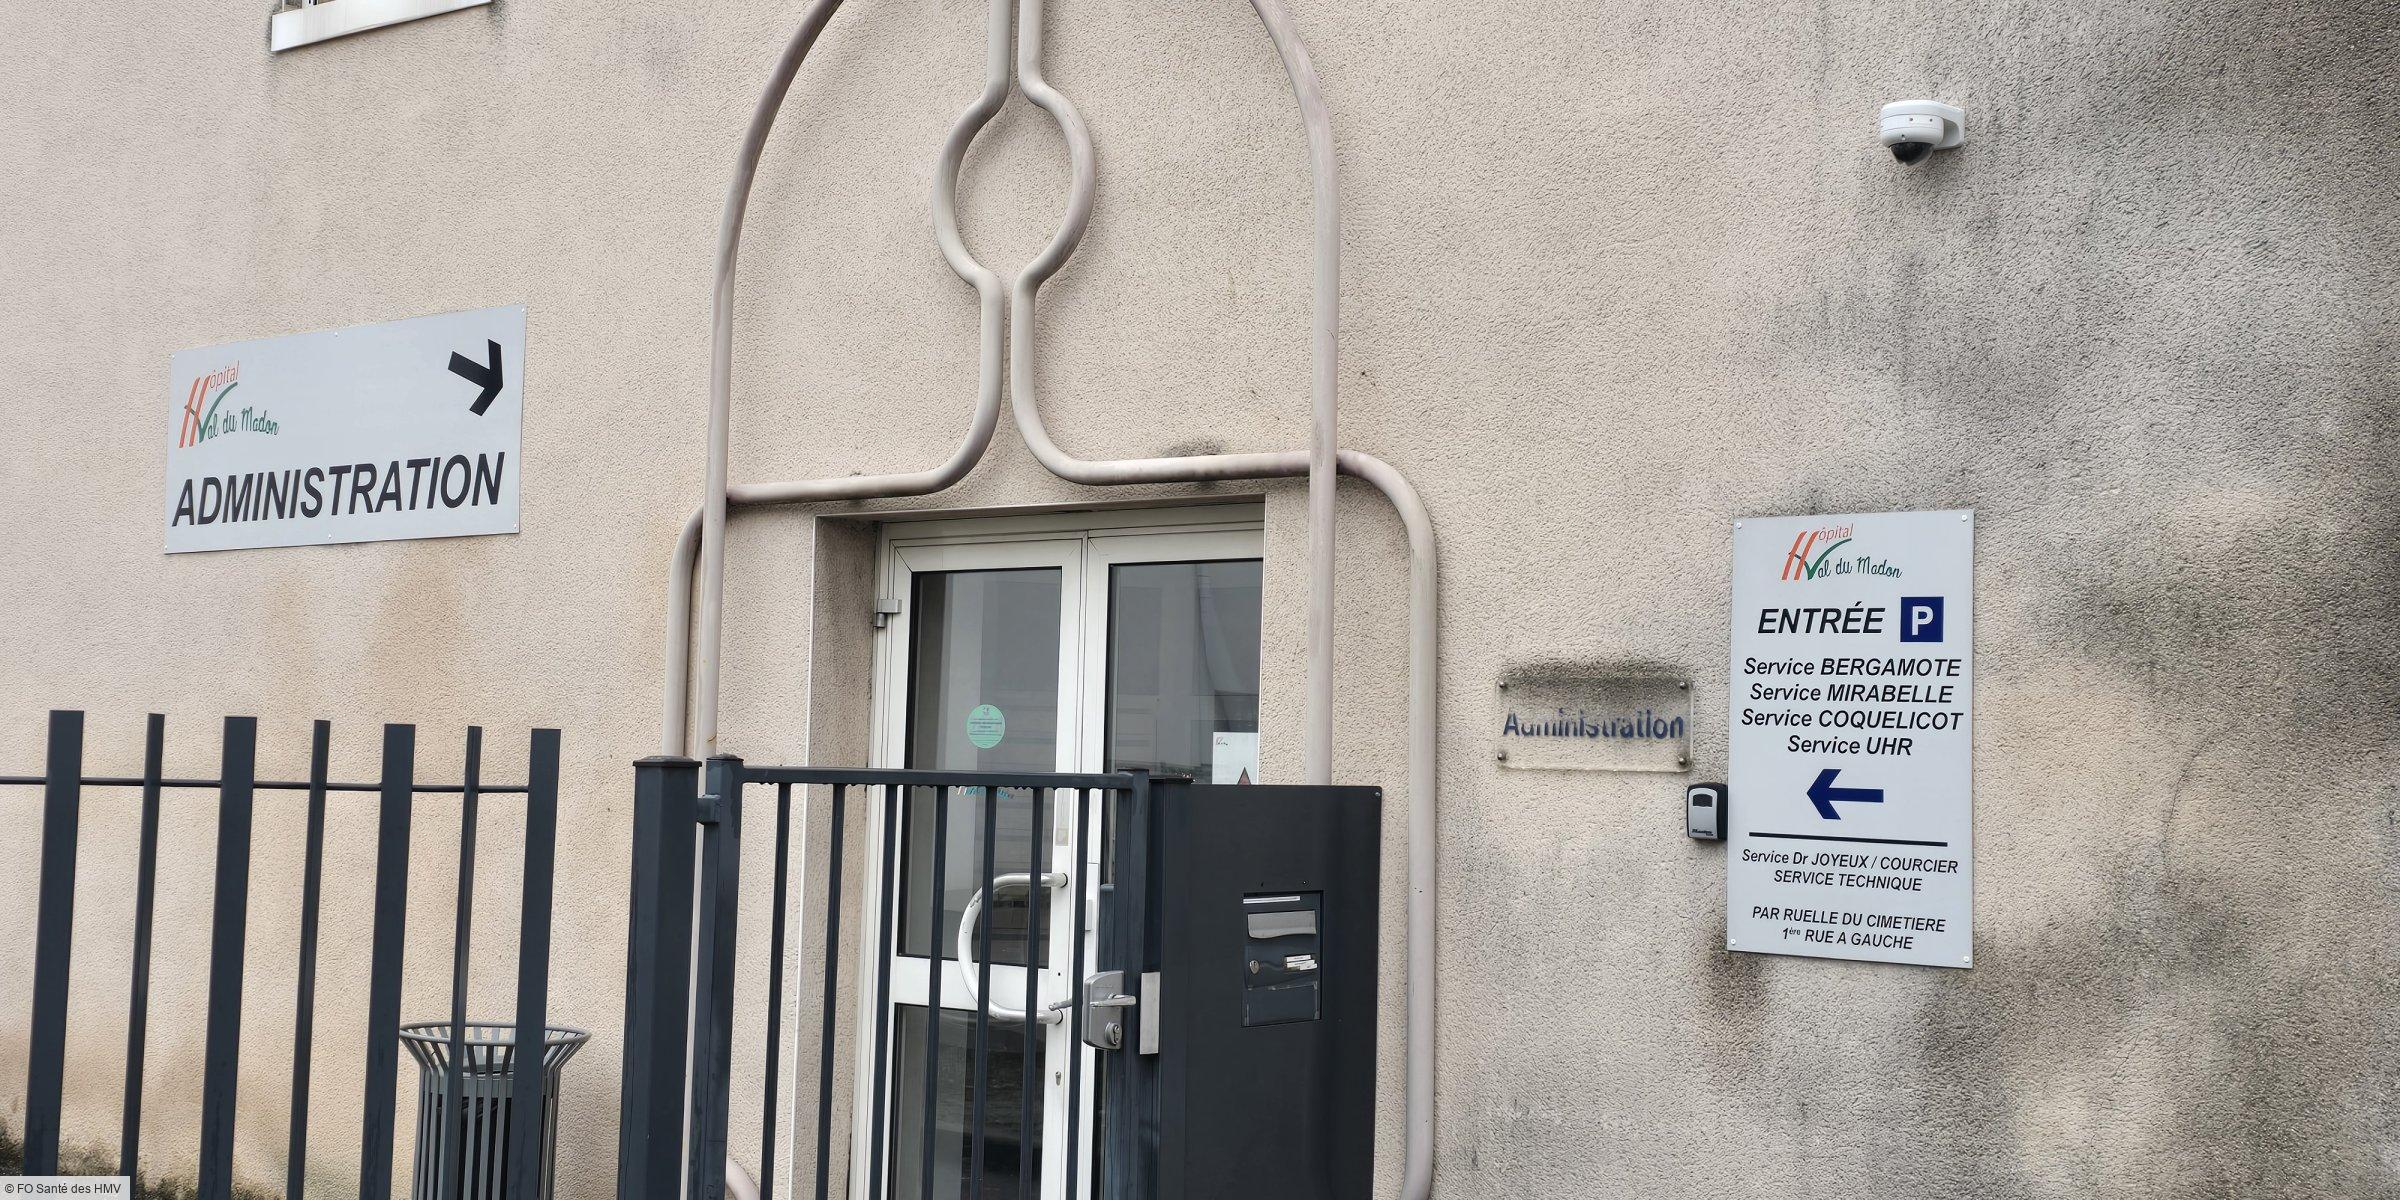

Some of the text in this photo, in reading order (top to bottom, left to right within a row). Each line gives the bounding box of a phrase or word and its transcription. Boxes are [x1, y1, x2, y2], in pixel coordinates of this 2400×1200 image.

[222, 410, 238, 434] du
[241, 406, 280, 436] Madon
[171, 451, 505, 527] ADMINISTRATION
[1835, 557, 1852, 575] du
[1857, 556, 1903, 579] Madon
[1757, 601, 1934, 636] ENTRÉE P
[1743, 657, 1962, 677] Service BERGAMOTE
[1750, 682, 1954, 704] Service MIRABELLE
[1741, 708, 1964, 731] Service COQUELICOT
[1787, 735, 1913, 756] Service UHR
[1742, 849, 1789, 864] Service
[1792, 852, 1809, 866] Dr
[1811, 853, 1870, 869] JOYEUX
[1880, 856, 1958, 874] COURCIER
[1773, 870, 1923, 892] SERVICE TECHNIQUE
[1752, 906, 1946, 932] PAR RUELLE DU CIMETIERE
[1804, 929, 1835, 944] RUE
[1836, 932, 1847, 945] A
[1850, 932, 1914, 949] GAUCHE
